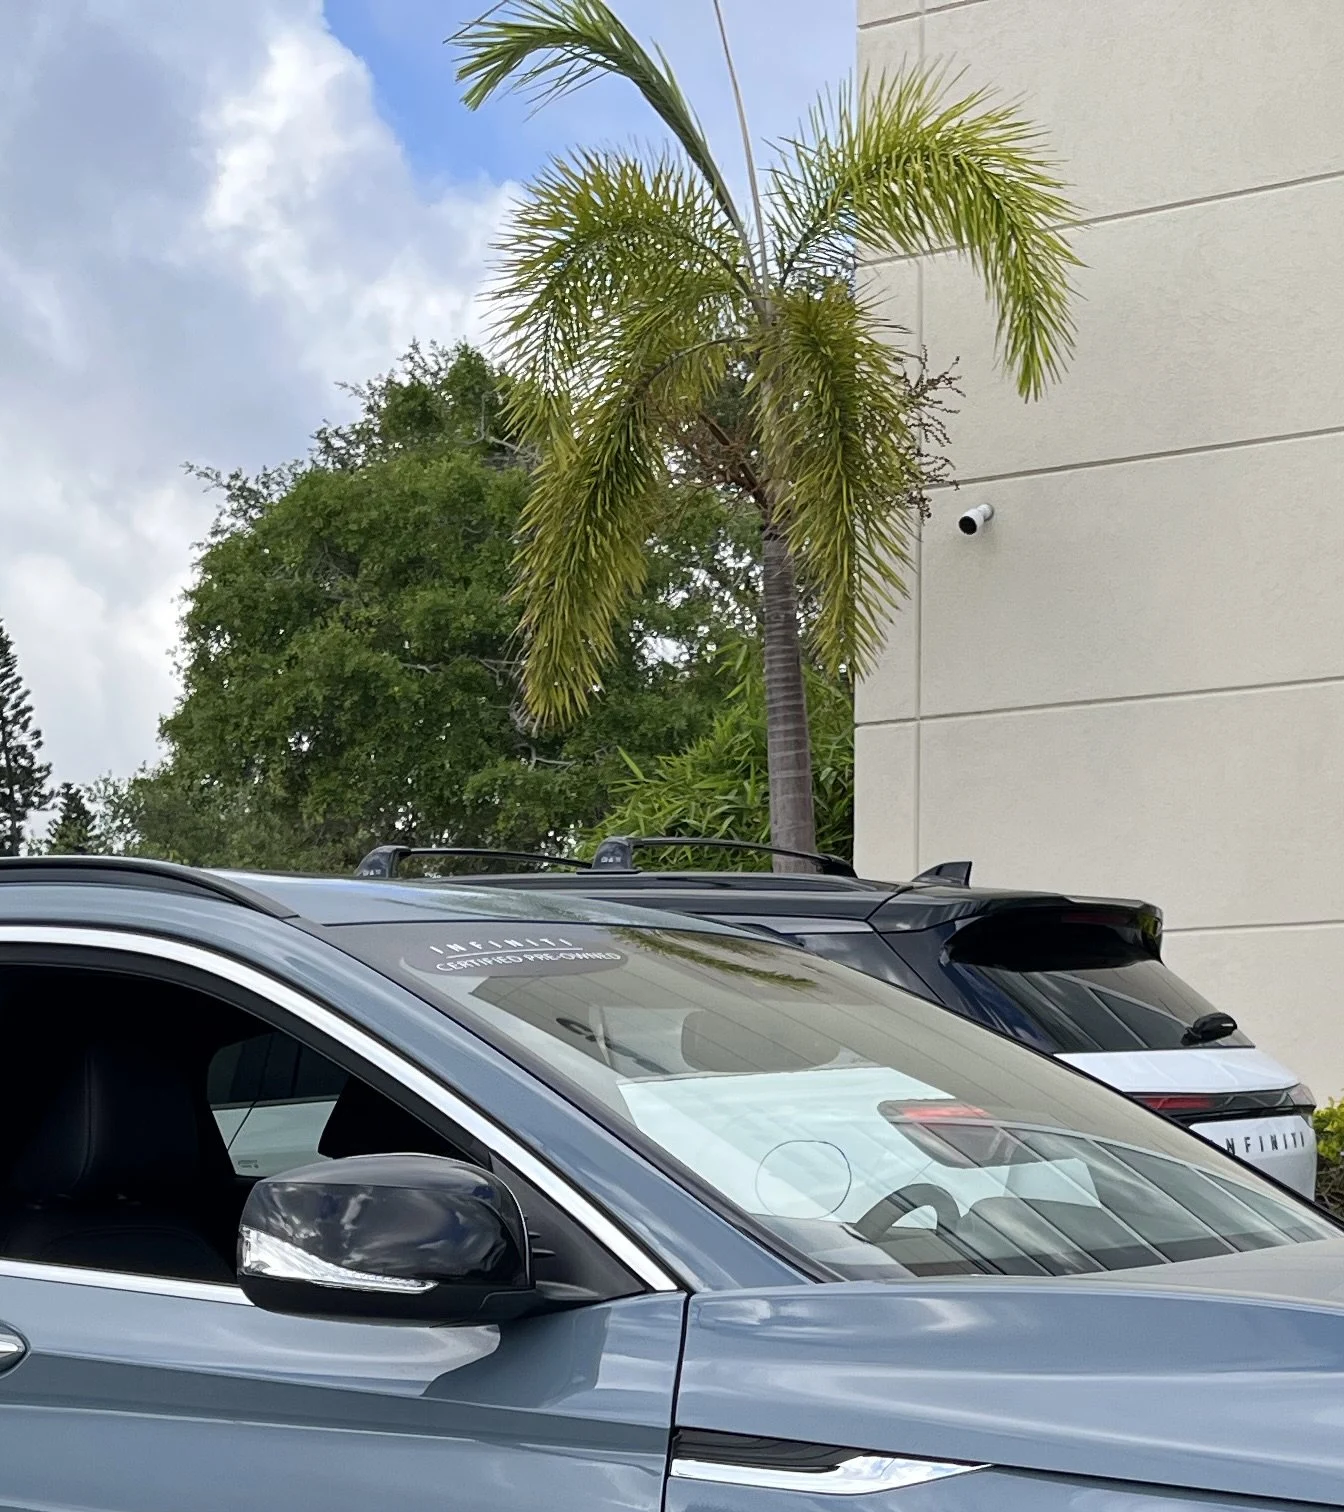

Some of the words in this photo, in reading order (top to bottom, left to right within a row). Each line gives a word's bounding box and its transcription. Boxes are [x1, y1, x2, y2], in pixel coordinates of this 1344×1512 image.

[430, 938, 573, 955] INFINITI
[436, 954, 523, 972] CERTIFIED
[523, 952, 622, 962] PRE-OWNED
[1224, 1131, 1306, 1155] NFINITI
